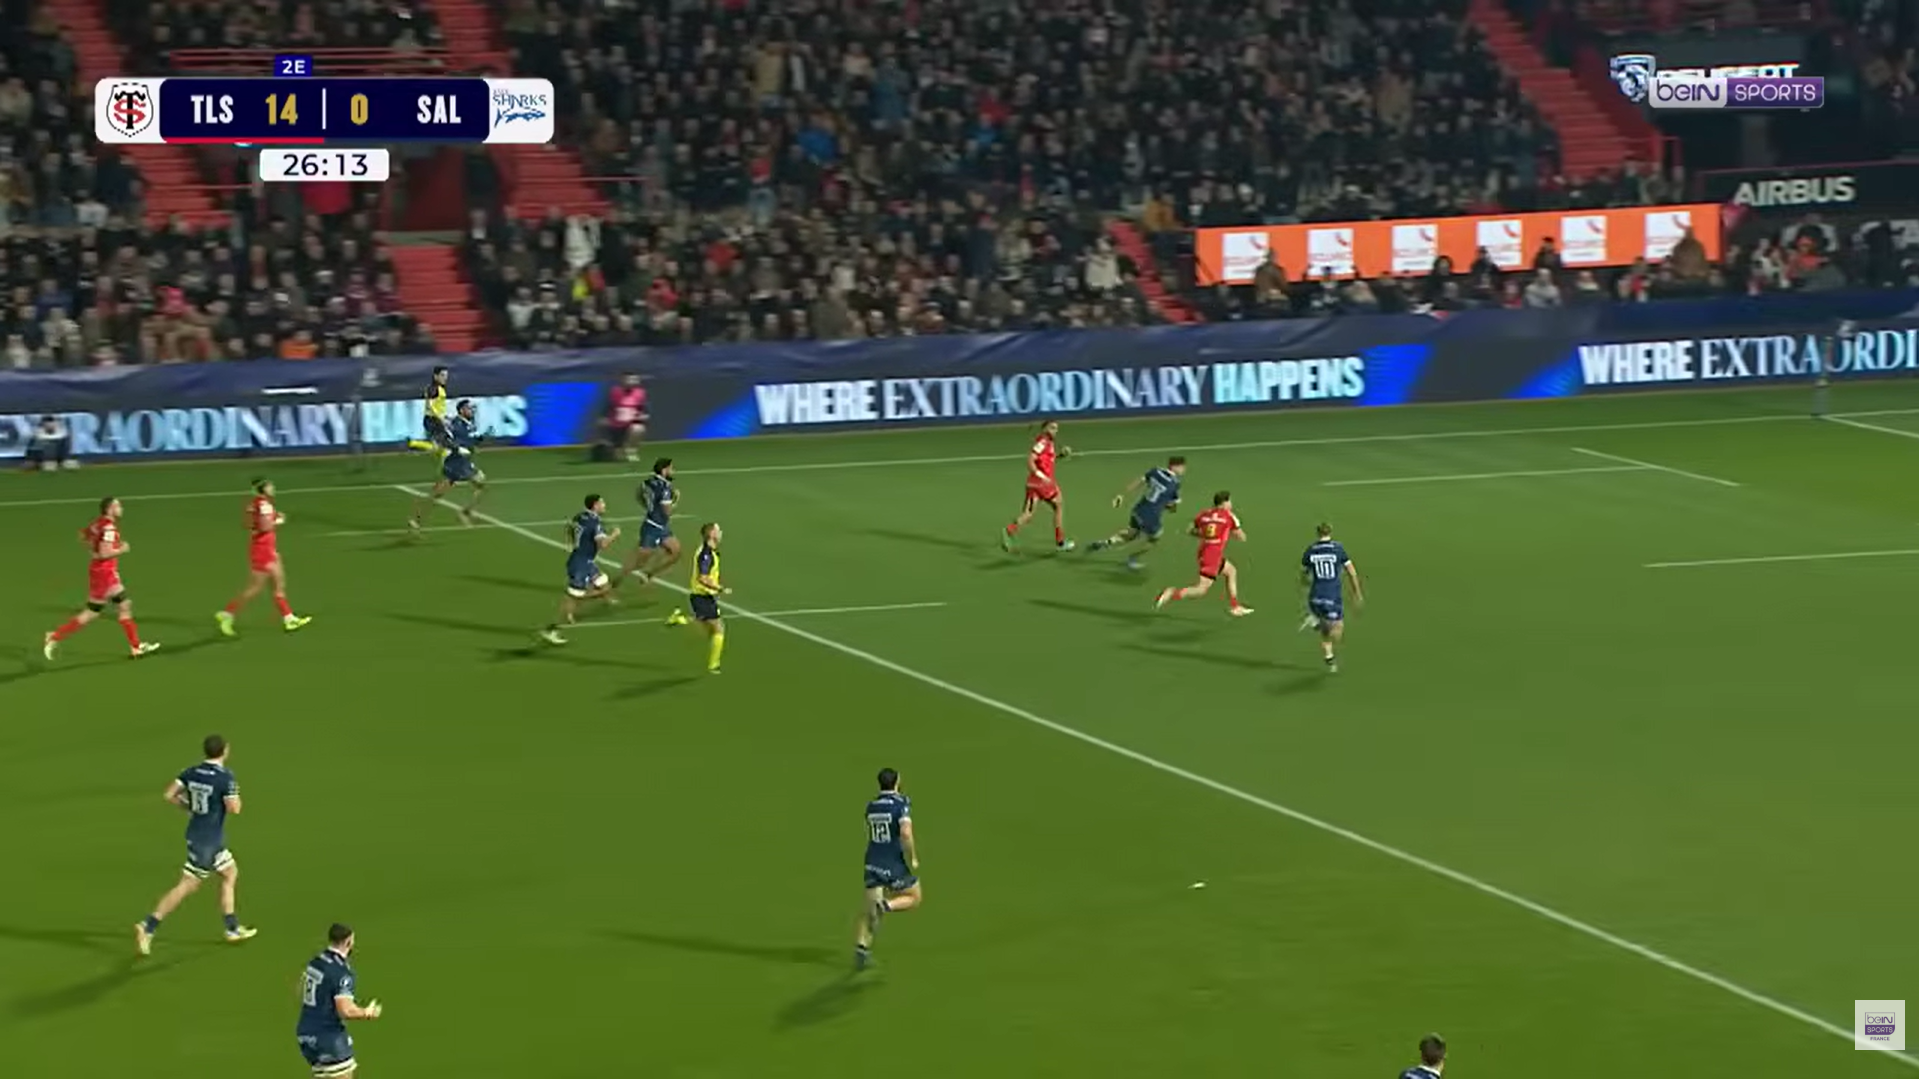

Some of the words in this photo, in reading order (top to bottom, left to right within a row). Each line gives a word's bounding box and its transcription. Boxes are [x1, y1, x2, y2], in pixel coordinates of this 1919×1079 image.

[1734, 176, 1856, 206] AIRBUS
[1578, 340, 1695, 384] WHERE
[755, 379, 880, 424] WHERE
[882, 365, 1208, 419] EXTRAORDINARY
[1212, 356, 1364, 403] HAPPENS
